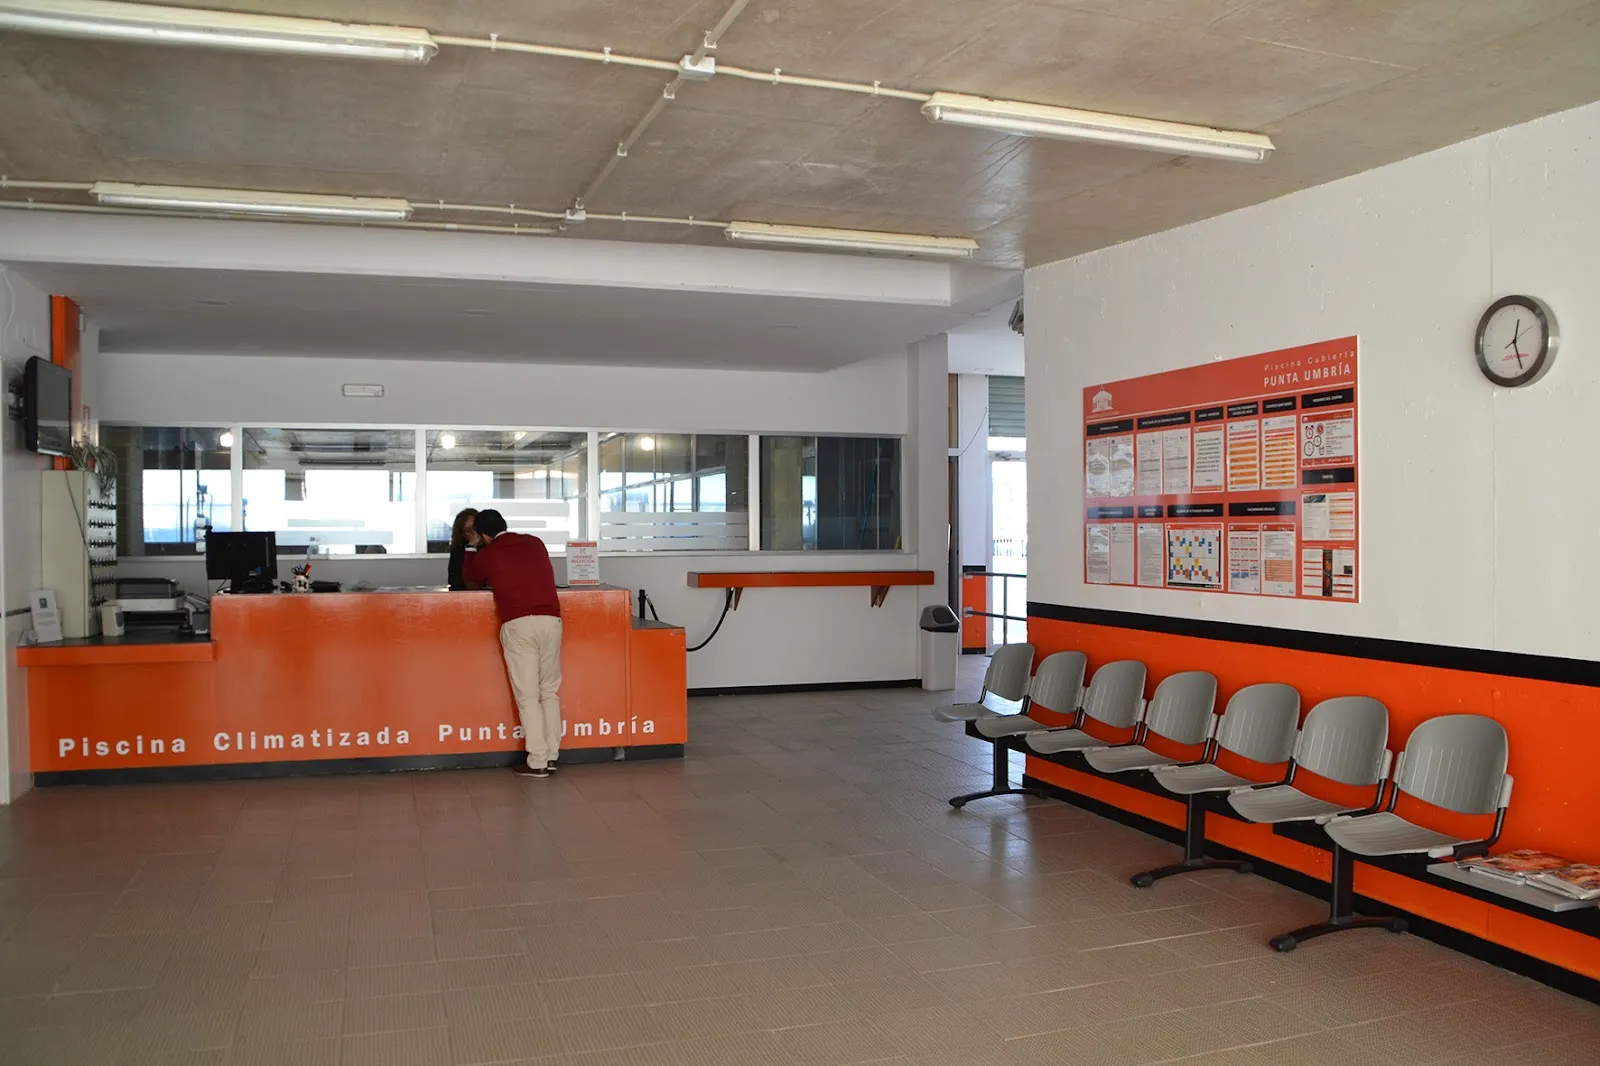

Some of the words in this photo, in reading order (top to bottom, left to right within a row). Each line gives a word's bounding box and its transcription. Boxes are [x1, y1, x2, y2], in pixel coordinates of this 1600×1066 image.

[1264, 360, 1301, 371] Piscina
[1307, 349, 1355, 364] Cubierta
[1263, 372, 1299, 387] PUNTA
[1304, 362, 1351, 381] UMBRÍA
[59, 736, 186, 757] Piscina
[213, 726, 410, 751] Climatizada
[438, 722, 523, 742] Punta
